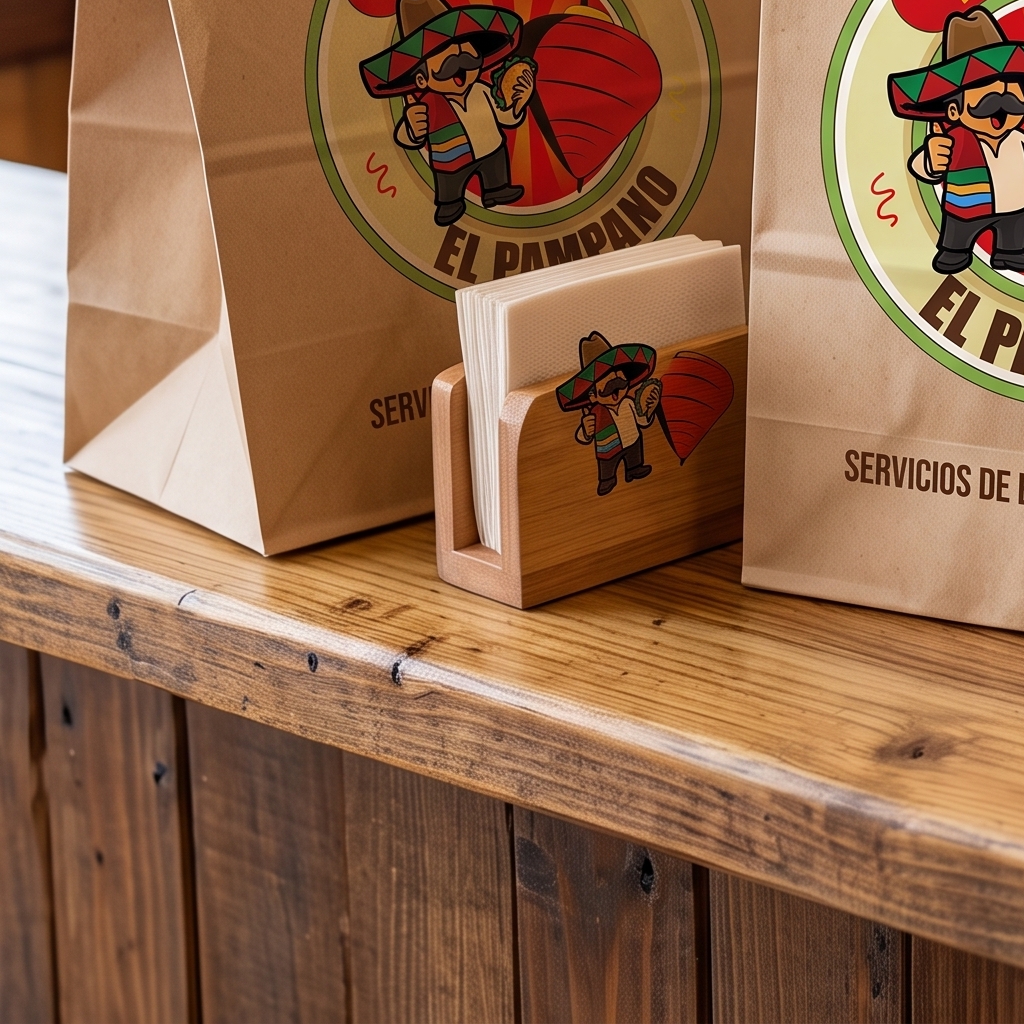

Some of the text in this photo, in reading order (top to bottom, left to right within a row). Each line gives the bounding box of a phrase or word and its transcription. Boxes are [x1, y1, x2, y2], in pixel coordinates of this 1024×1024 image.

[433, 225, 481, 284] EL
[919, 274, 981, 347] EL
[844, 449, 971, 497] SERVICIOS
[979, 466, 1011, 503] DE
